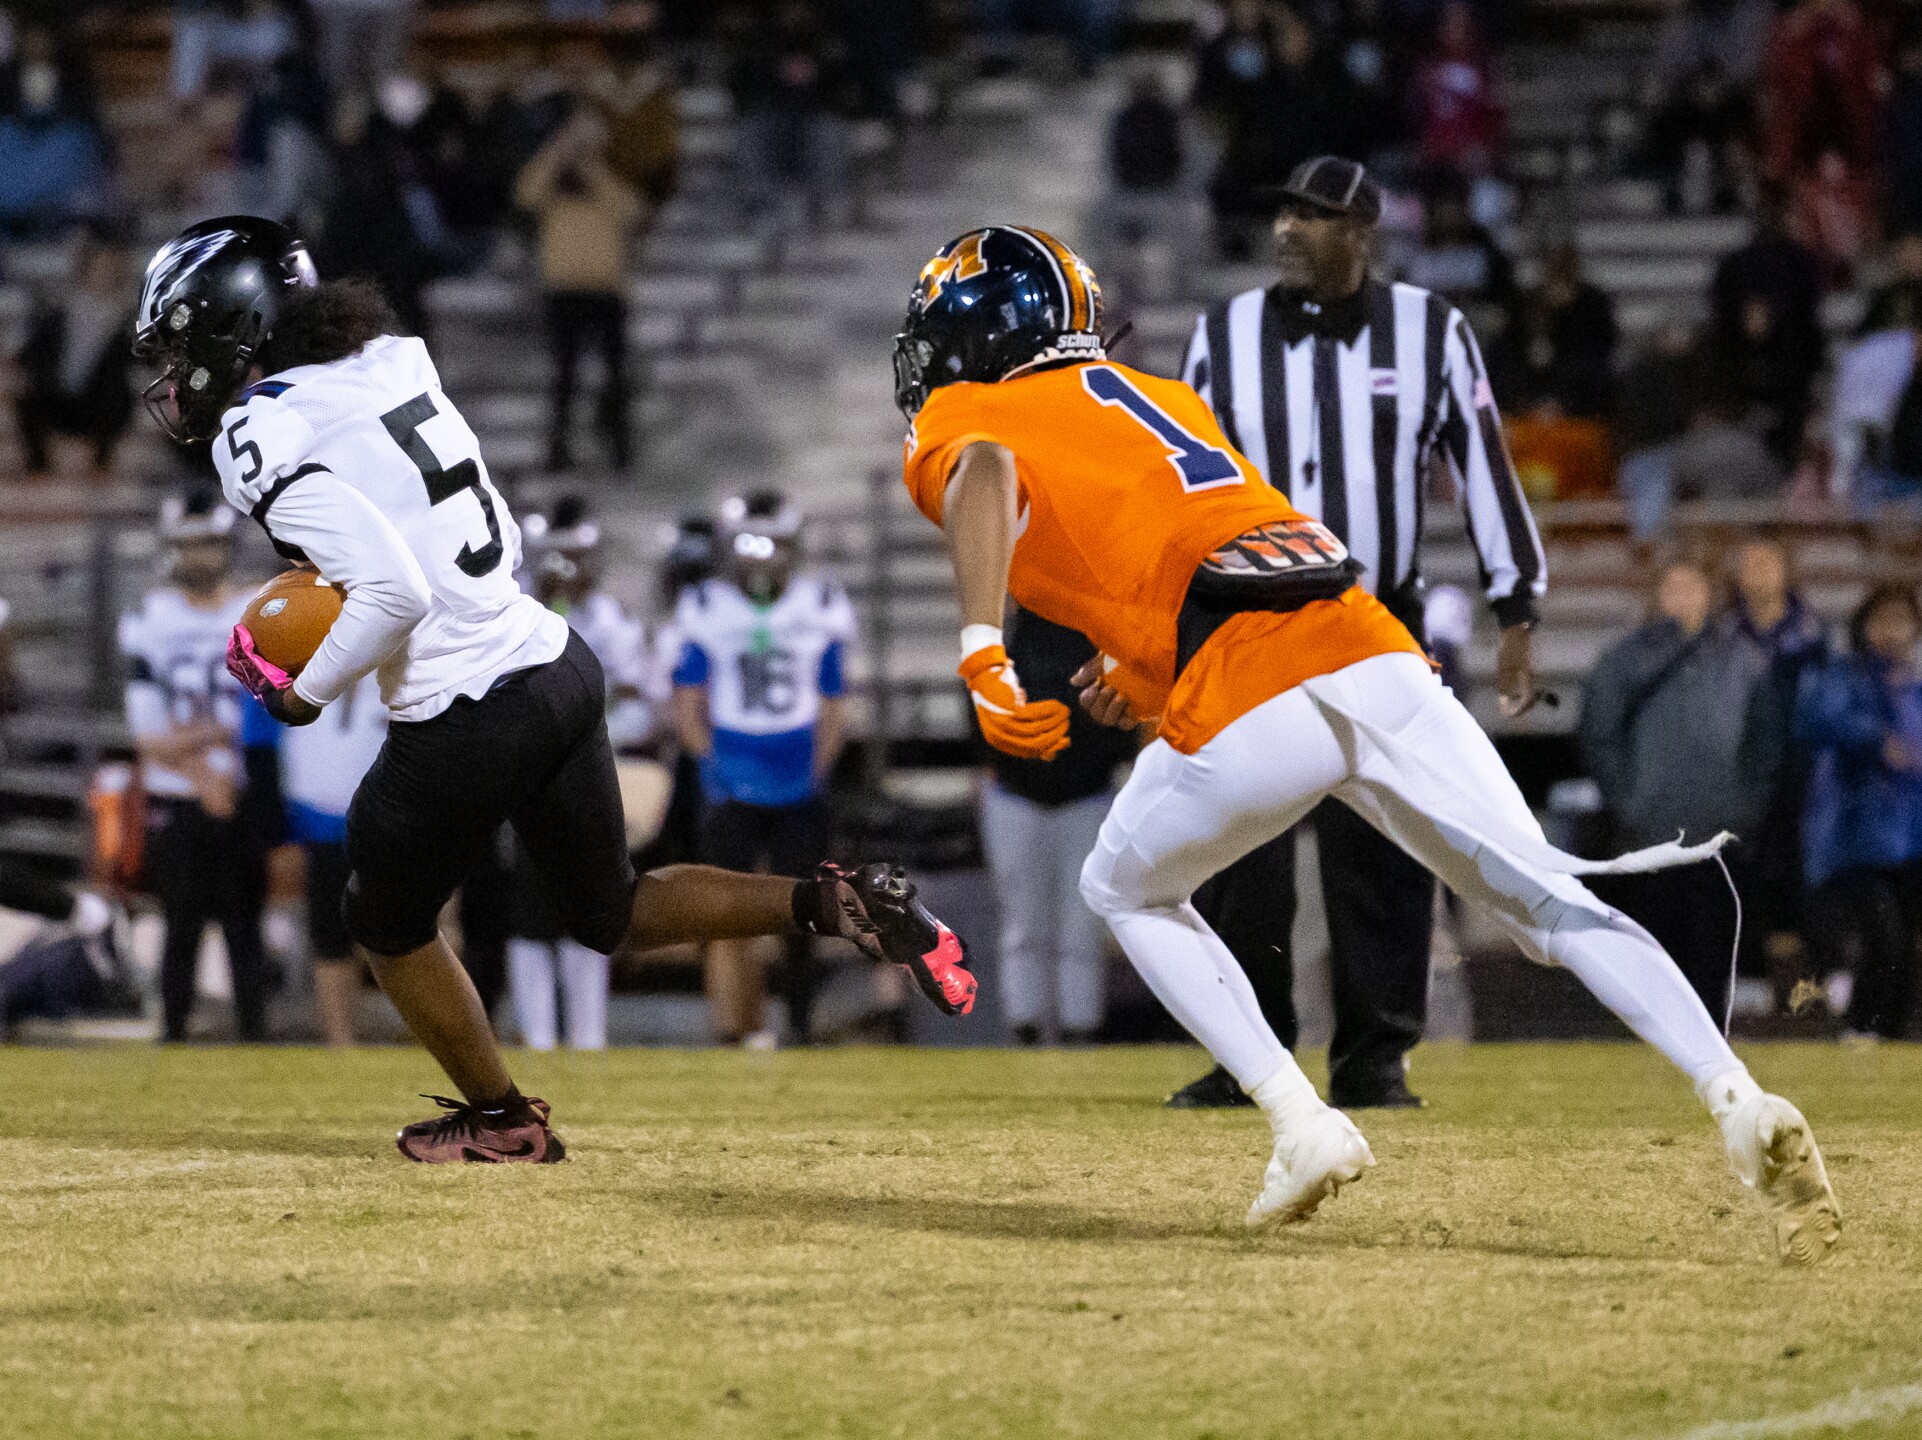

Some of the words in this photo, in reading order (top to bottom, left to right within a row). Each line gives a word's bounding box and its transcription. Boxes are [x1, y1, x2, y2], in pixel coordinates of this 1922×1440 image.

[227, 415, 263, 484] 5
[379, 391, 504, 578] 5
[1080, 365, 1246, 494] 1
